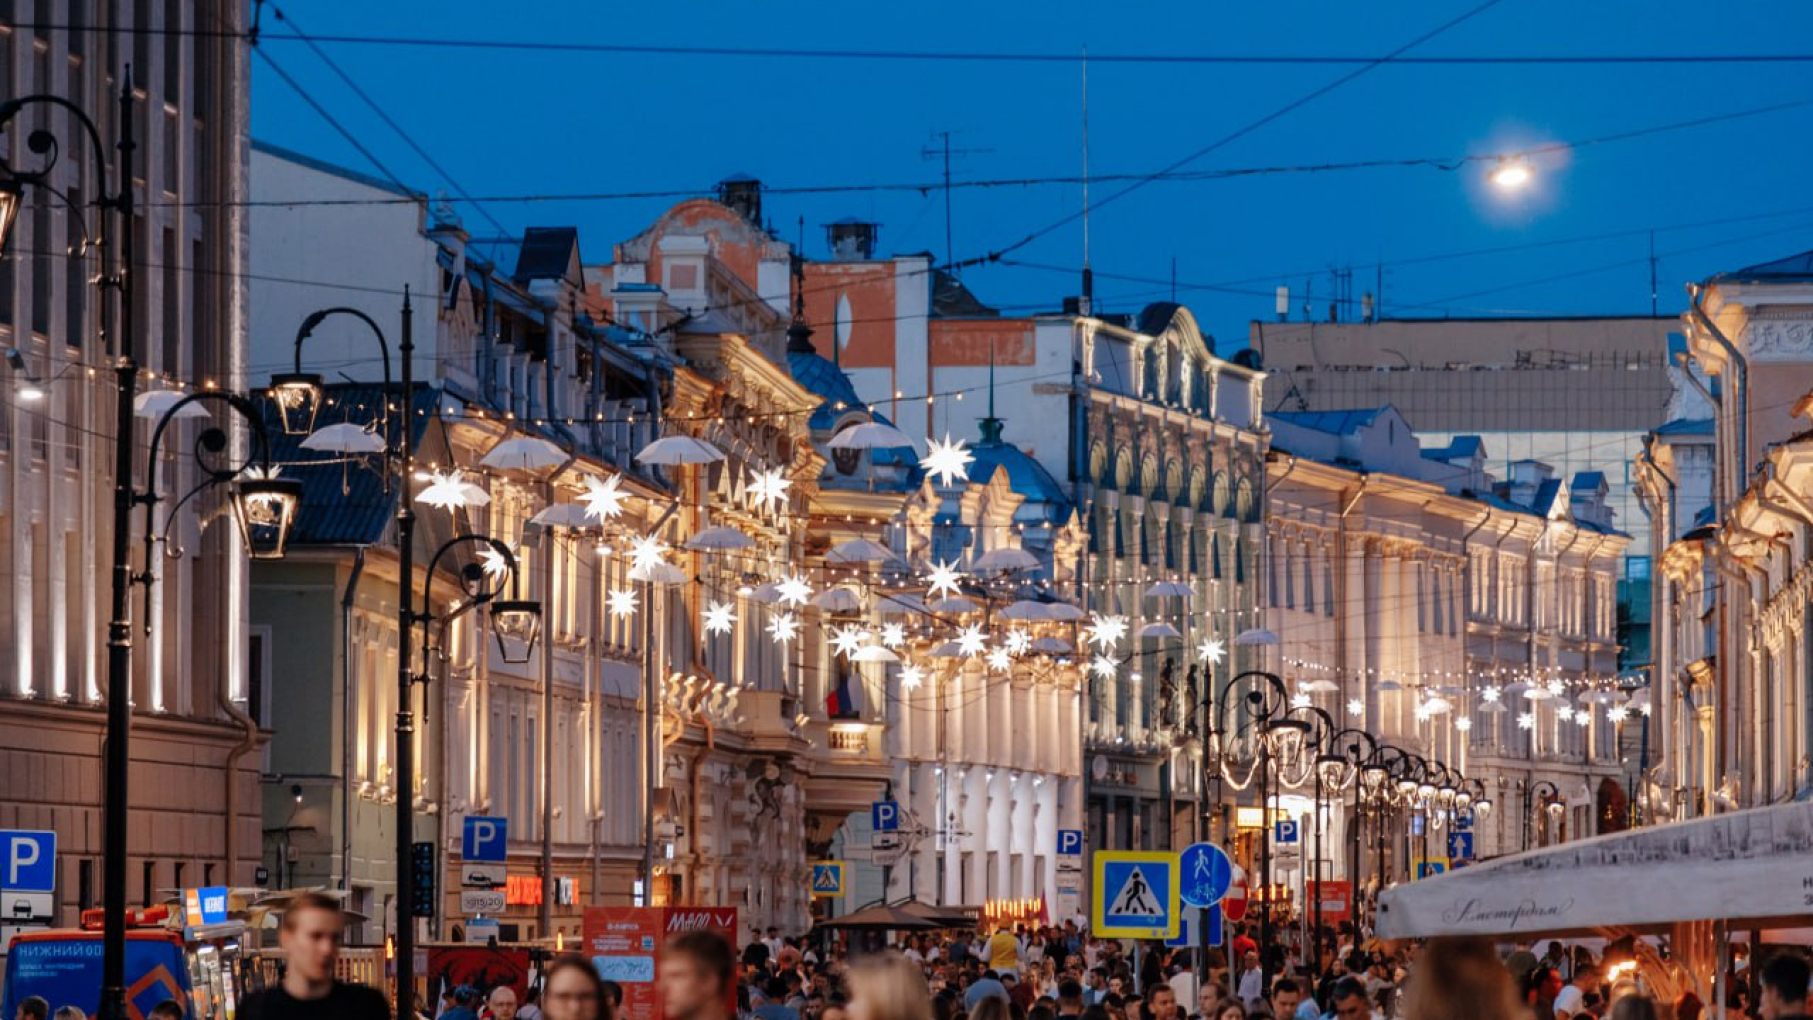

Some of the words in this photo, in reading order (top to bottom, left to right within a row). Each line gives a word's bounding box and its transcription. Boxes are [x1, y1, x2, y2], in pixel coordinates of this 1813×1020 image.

[879, 804, 894, 829] P
[473, 821, 496, 857] P
[1063, 832, 1078, 853] P
[1281, 822, 1294, 840] P
[9, 836, 40, 885] P
[19, 942, 83, 957] НИЖНИЙ
